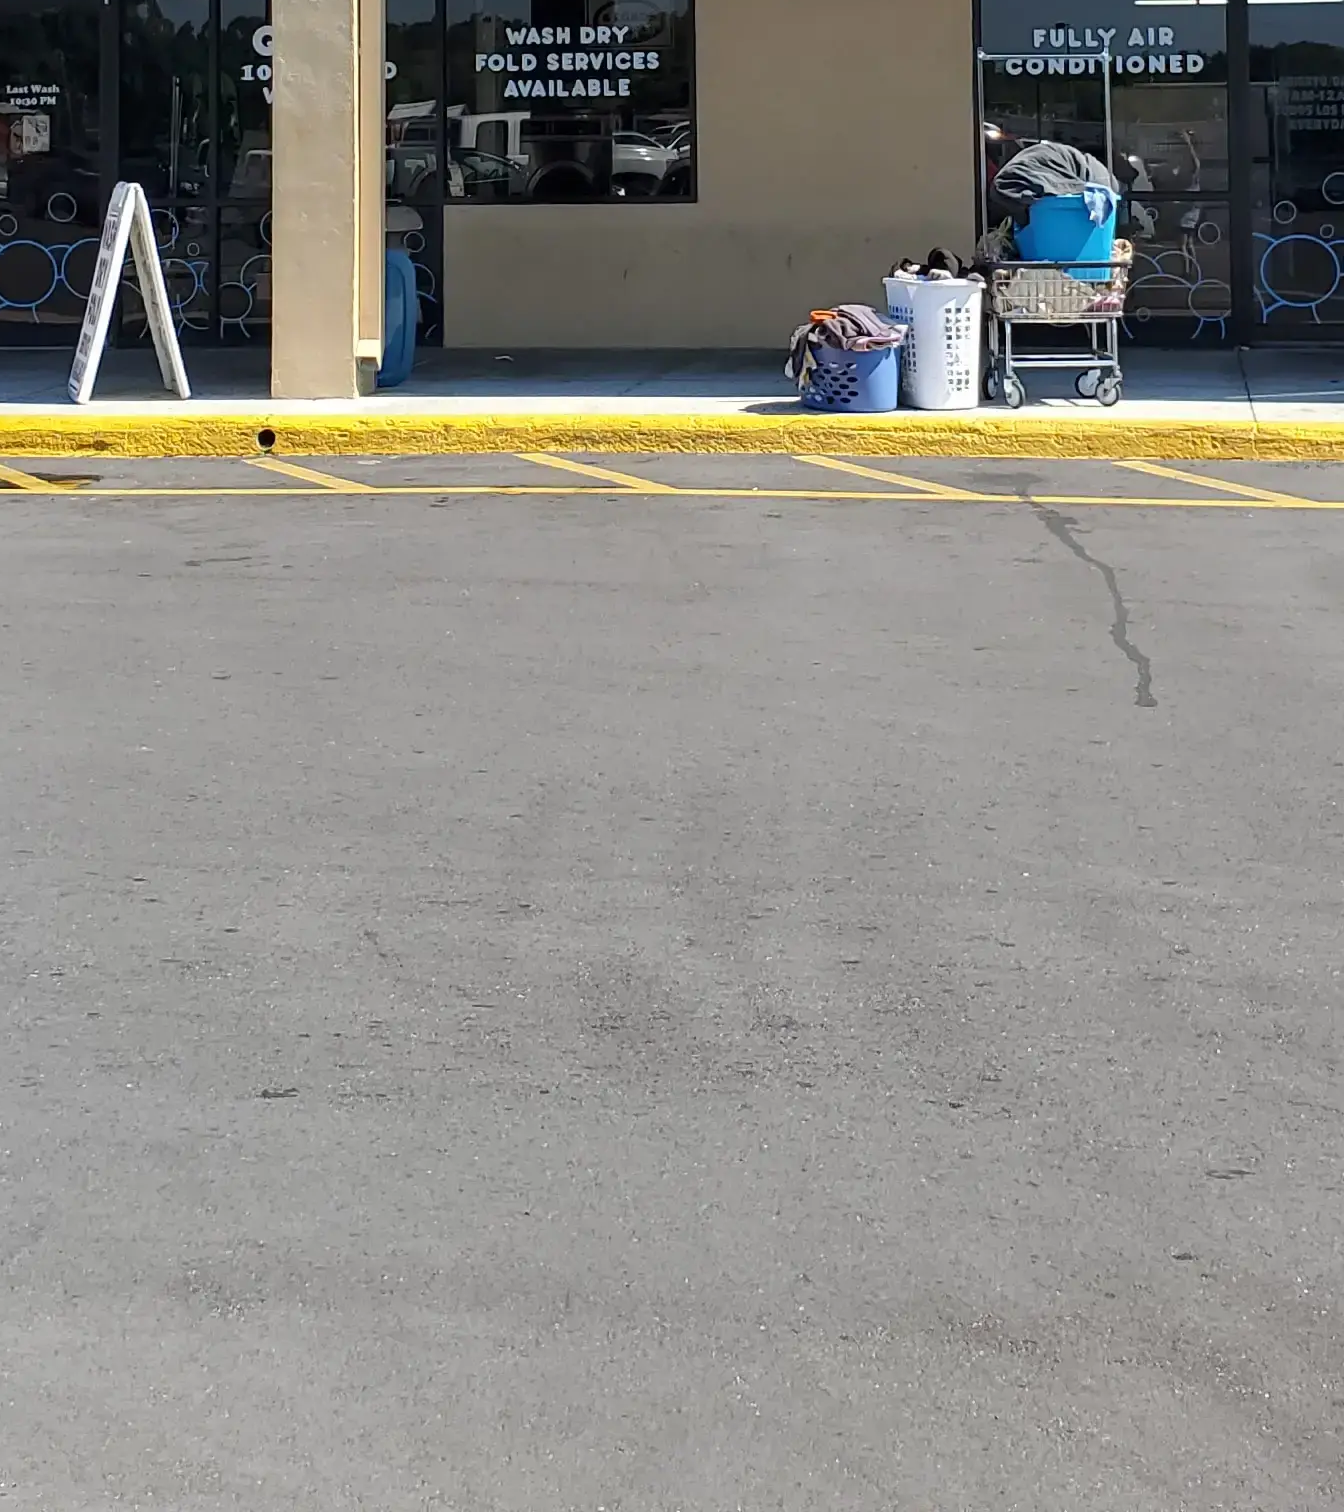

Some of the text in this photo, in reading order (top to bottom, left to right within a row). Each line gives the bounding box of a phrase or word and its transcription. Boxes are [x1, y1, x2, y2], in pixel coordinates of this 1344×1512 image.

[506, 26, 629, 45] WASH DRY
[1033, 27, 1174, 48] FULLY AIR
[475, 52, 660, 72] FOLD SERVICES
[6, 84, 60, 94] Last Wash
[504, 79, 631, 98] AVAILABLE
[10, 96, 56, 106] 10:30 PM
